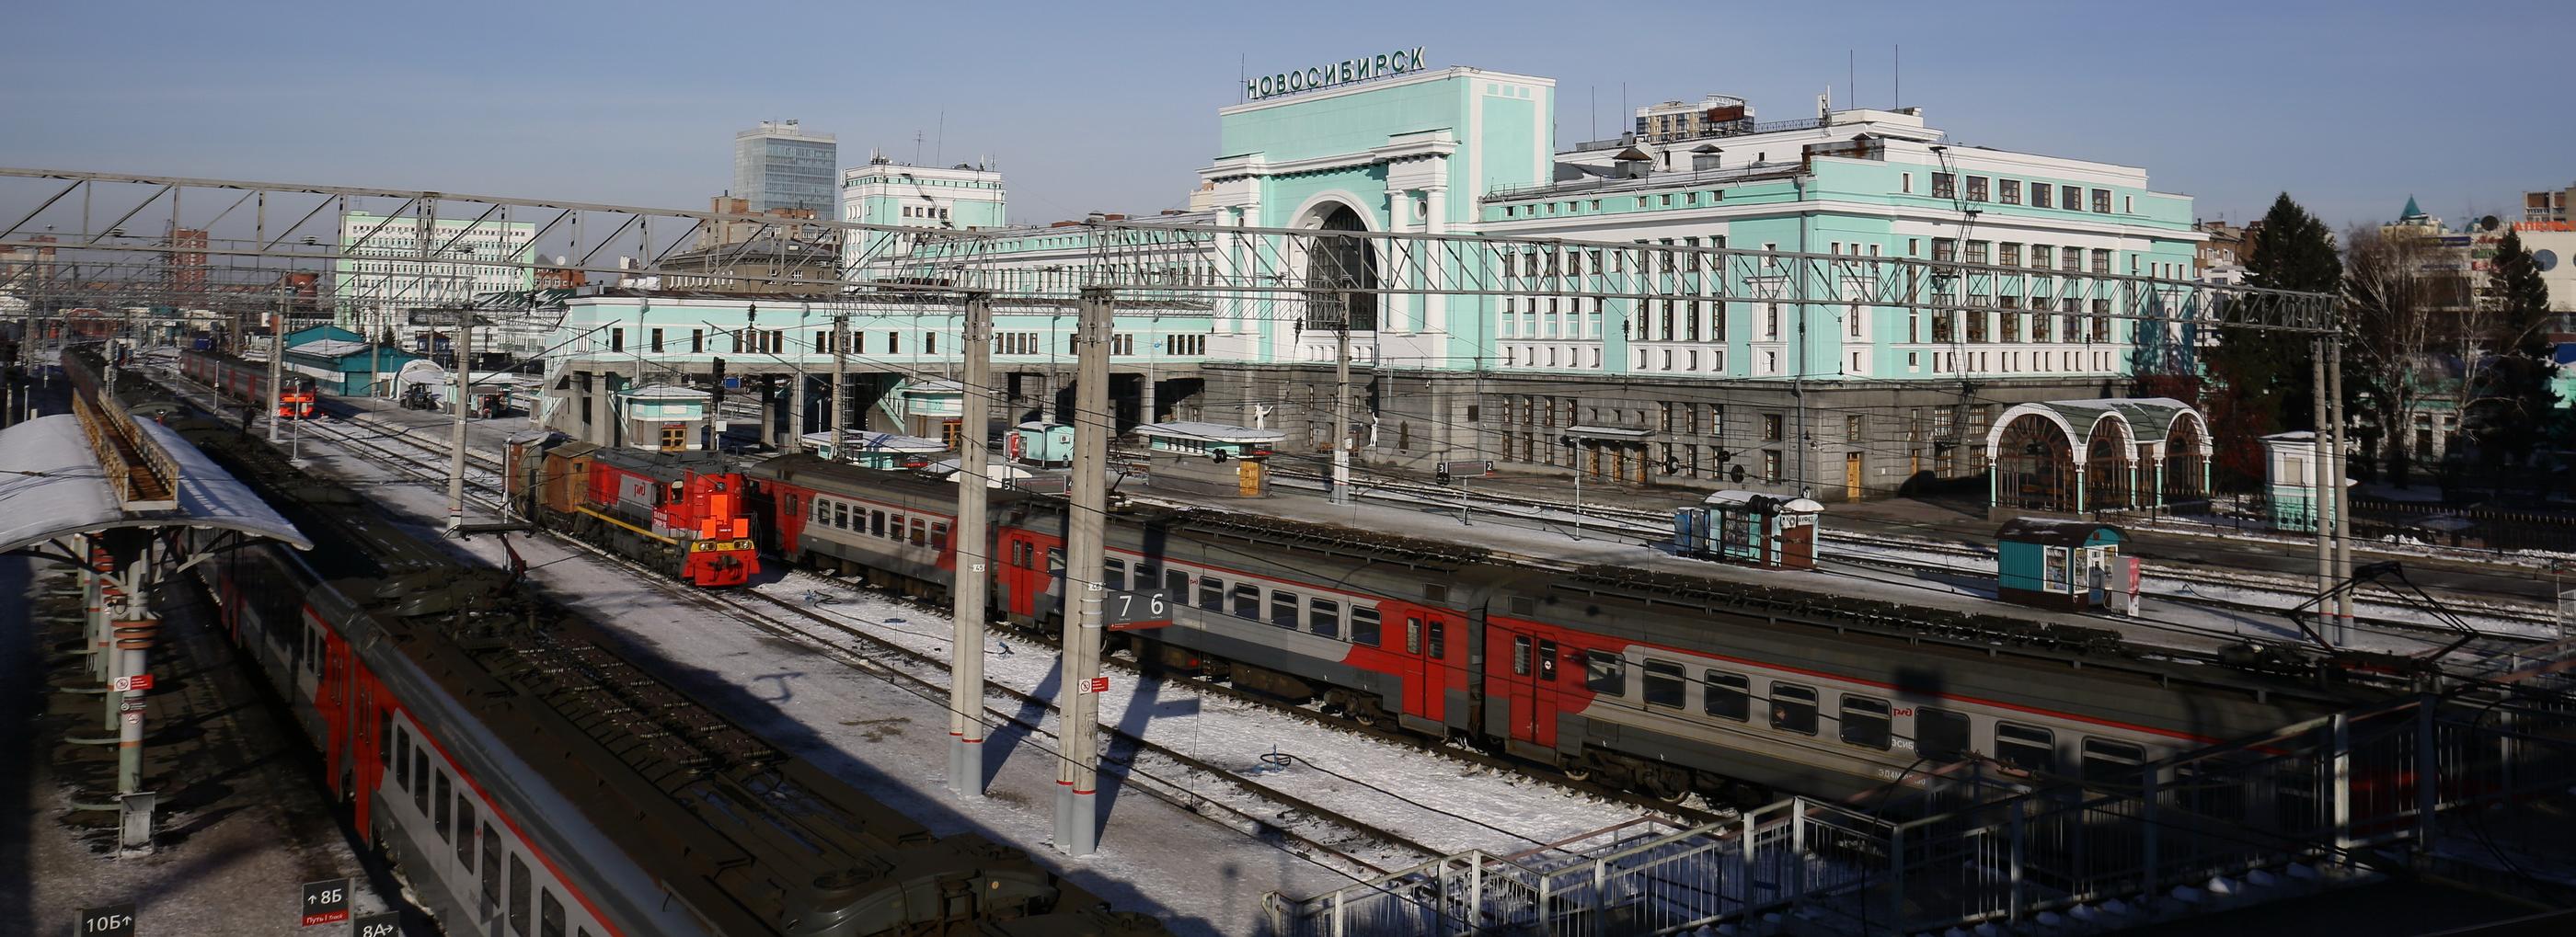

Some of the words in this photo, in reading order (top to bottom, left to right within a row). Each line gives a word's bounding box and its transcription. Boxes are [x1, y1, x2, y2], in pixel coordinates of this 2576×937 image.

[1248, 45, 1426, 99] НОВОСИБИРСК
[1439, 464, 1444, 473] 3
[1487, 463, 1492, 471] 2
[1004, 480, 1010, 490] 5
[1119, 595, 1133, 617] 7
[1151, 593, 1164, 615] 6
[320, 888, 342, 904] 8Б
[86, 914, 121, 933] 10Б
[306, 917, 324, 925] Путь
[362, 923, 386, 937] 8А
